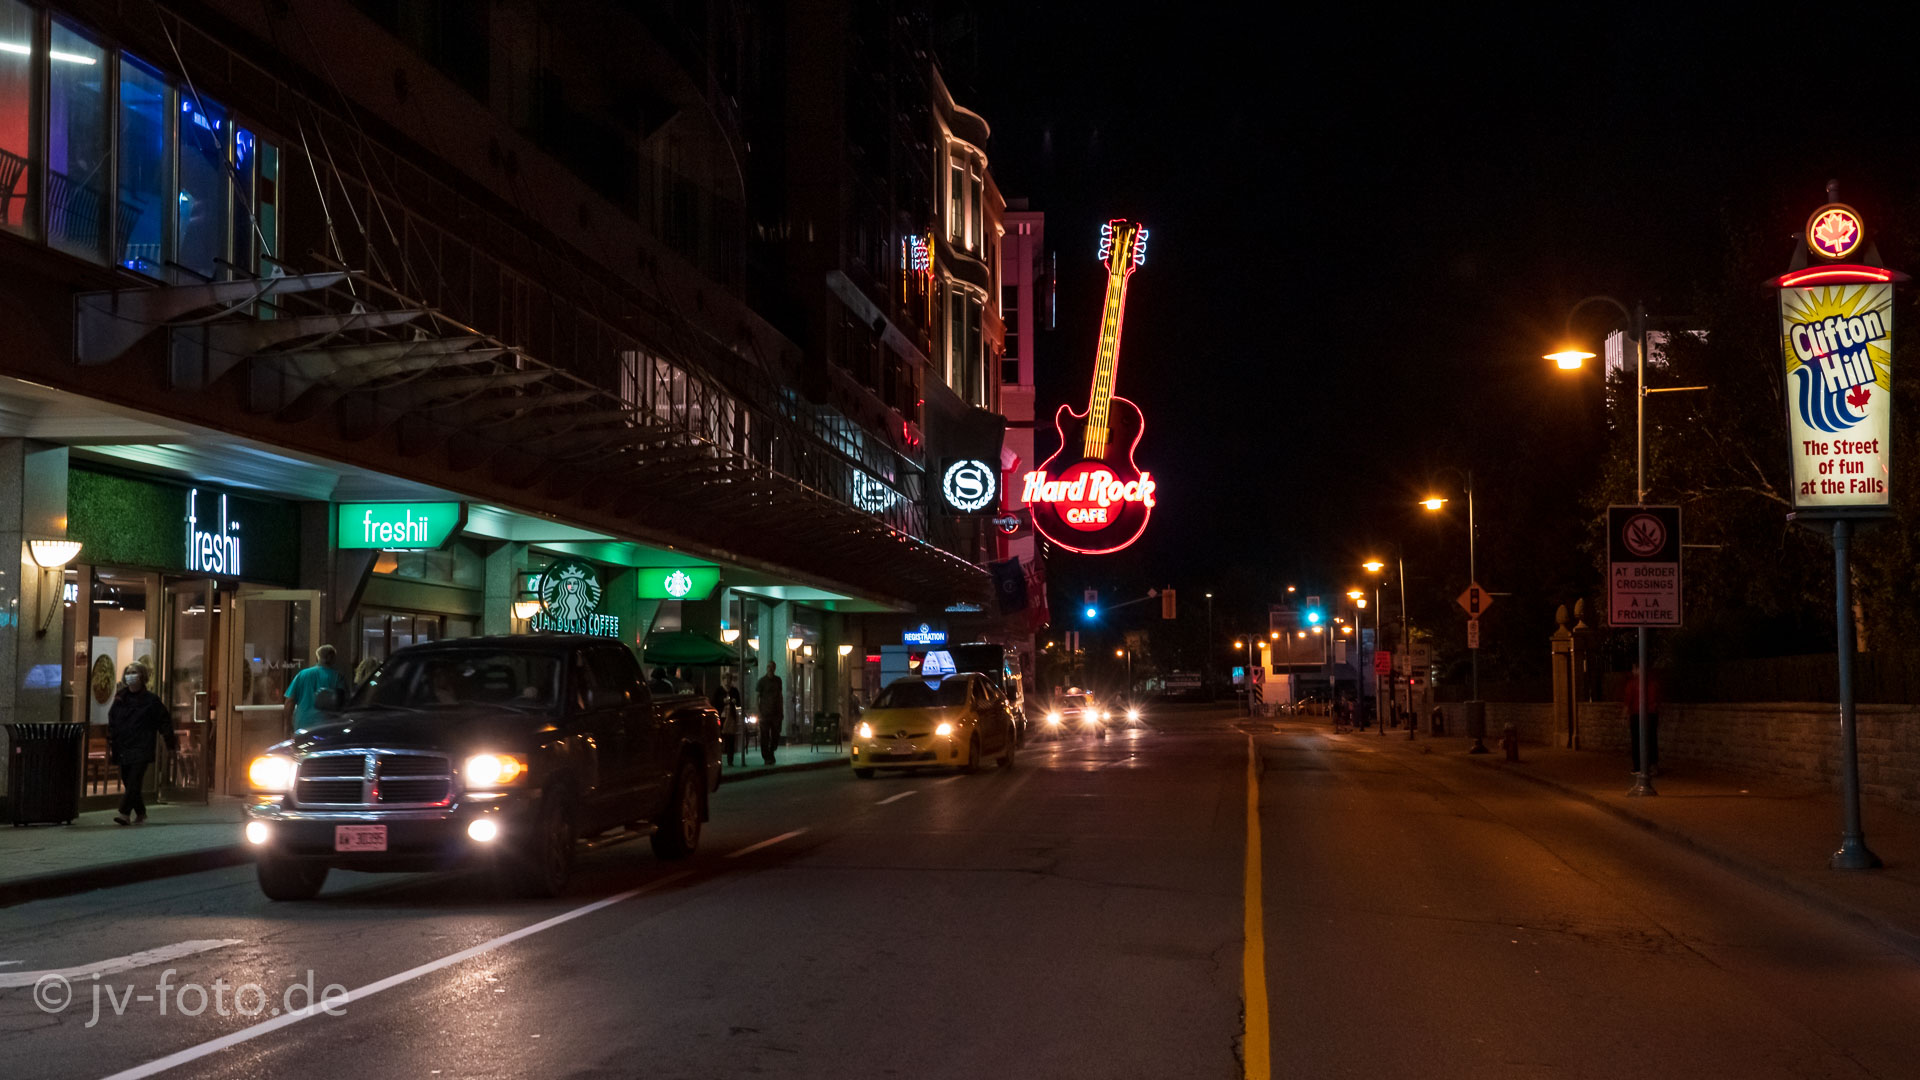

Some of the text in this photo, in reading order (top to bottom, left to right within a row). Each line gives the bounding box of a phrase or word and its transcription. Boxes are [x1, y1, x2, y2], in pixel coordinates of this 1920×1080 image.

[1791, 310, 1885, 362] Clifton
[1818, 347, 1877, 395] Hill
[1803, 438, 1879, 456] The Street
[1819, 459, 1864, 474] of fun
[955, 468, 984, 500] S
[1021, 469, 1156, 507] Hard Rock
[1800, 477, 1883, 495] at the Falls
[1066, 508, 1108, 523] CAFE
[187, 488, 241, 575] freshii
[363, 509, 429, 543] freshii
[1615, 567, 1675, 577] AT BORDER
[1616, 579, 1673, 589] CROSSINGS
[1645, 597, 1659, 607] LA
[588, 613, 619, 637] COFFEE
[904, 632, 945, 641] REGISTRATION
